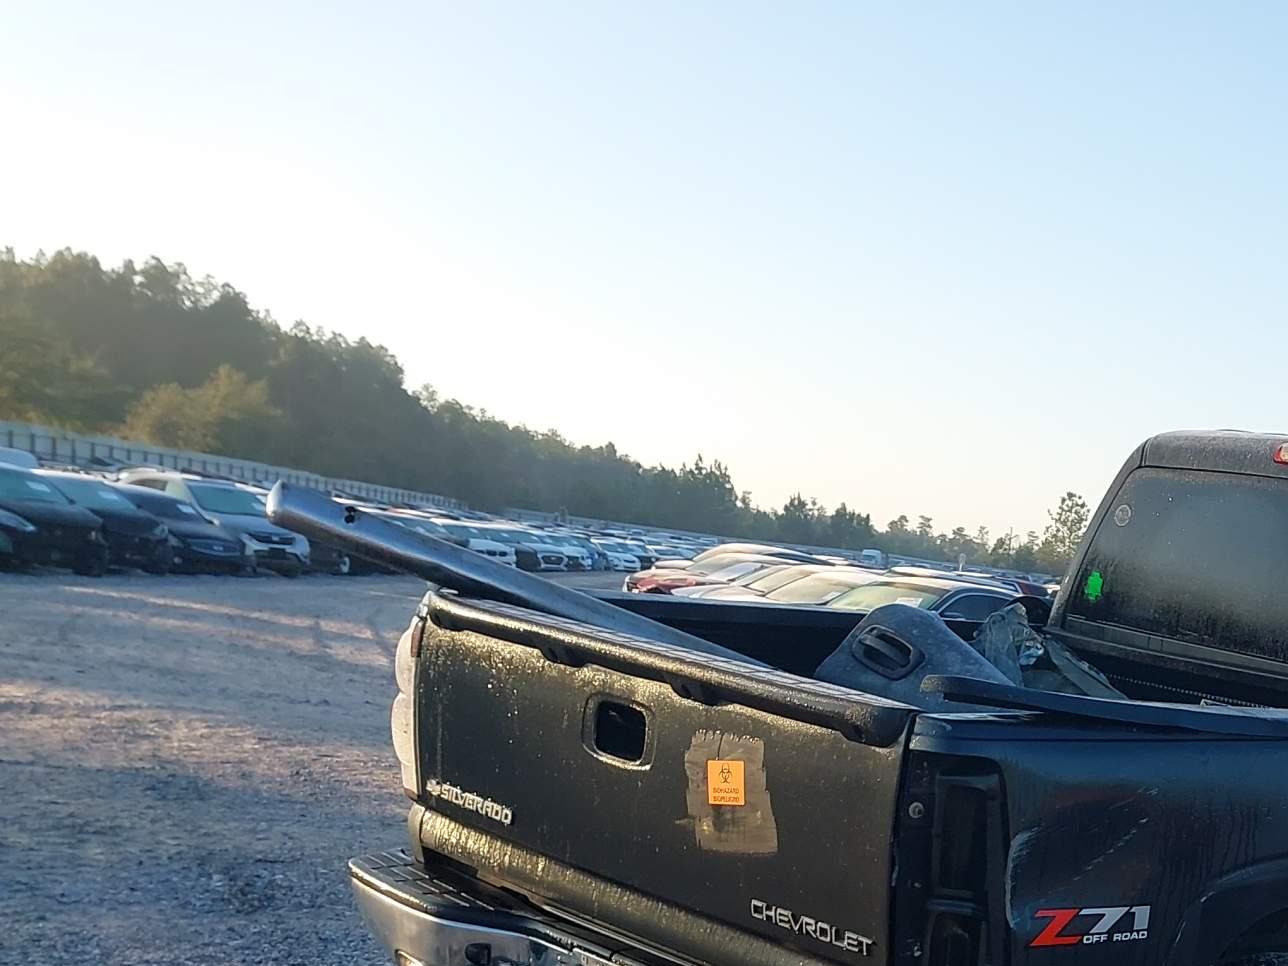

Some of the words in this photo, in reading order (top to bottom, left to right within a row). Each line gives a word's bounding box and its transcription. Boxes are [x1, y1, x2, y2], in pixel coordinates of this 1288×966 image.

[440, 782, 513, 825] SILVERADO
[750, 898, 874, 956] CHEVROLET
[1029, 904, 1152, 948] Z71
[1082, 933, 1108, 945] OFF
[1112, 930, 1148, 943] ROAD
